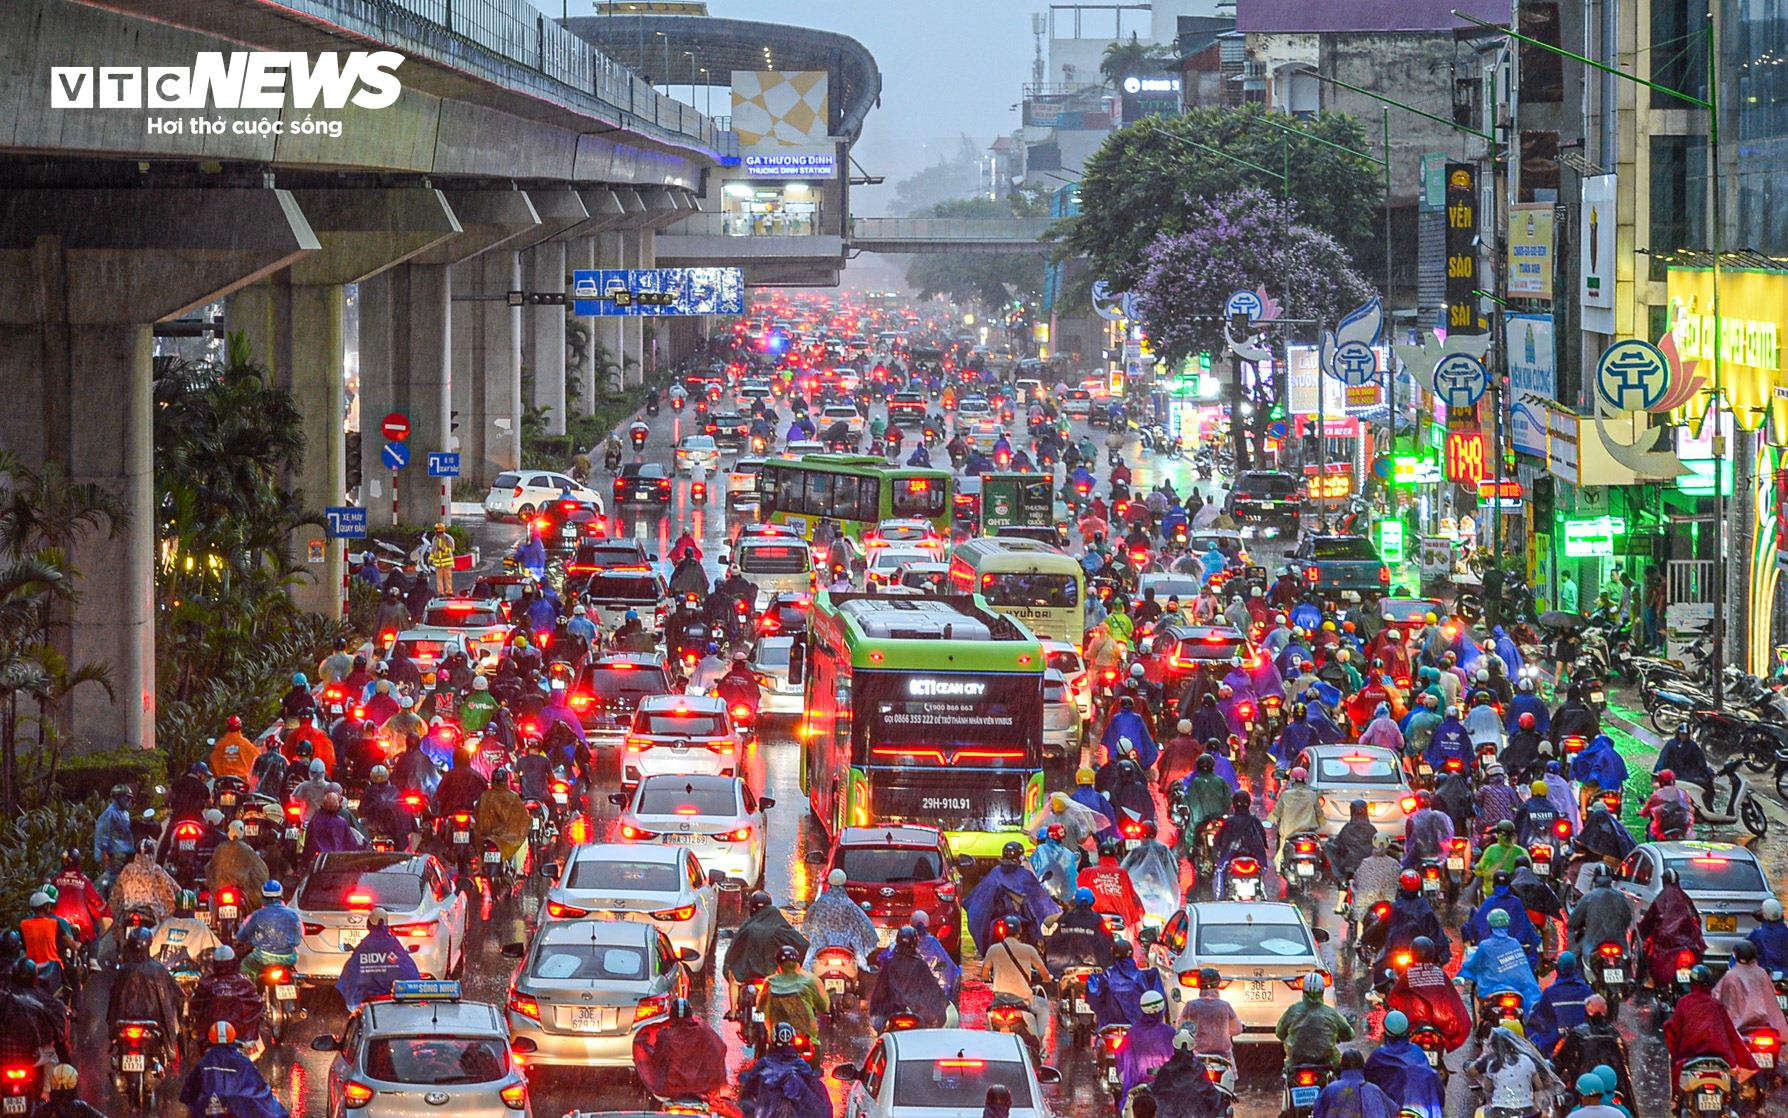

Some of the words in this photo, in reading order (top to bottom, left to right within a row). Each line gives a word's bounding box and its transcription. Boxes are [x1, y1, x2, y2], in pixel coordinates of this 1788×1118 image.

[746, 156, 762, 165] GA
[1449, 200, 1472, 228] YẾN
[1449, 253, 1472, 278] SÀO
[1451, 302, 1471, 327] SÀI
[340, 524, 353, 532] QUAY
[909, 715, 922, 724] 355
[922, 715, 934, 724] 222
[951, 716, 968, 726] THÀNH
[969, 716, 983, 726] NHÂN
[994, 717, 1013, 725] VINBUS
[922, 798, 970, 809] 29H-910.91
[359, 953, 387, 964] BIDV
[419, 982, 438, 993] SÔNG
[579, 1009, 595, 1019] 30E
